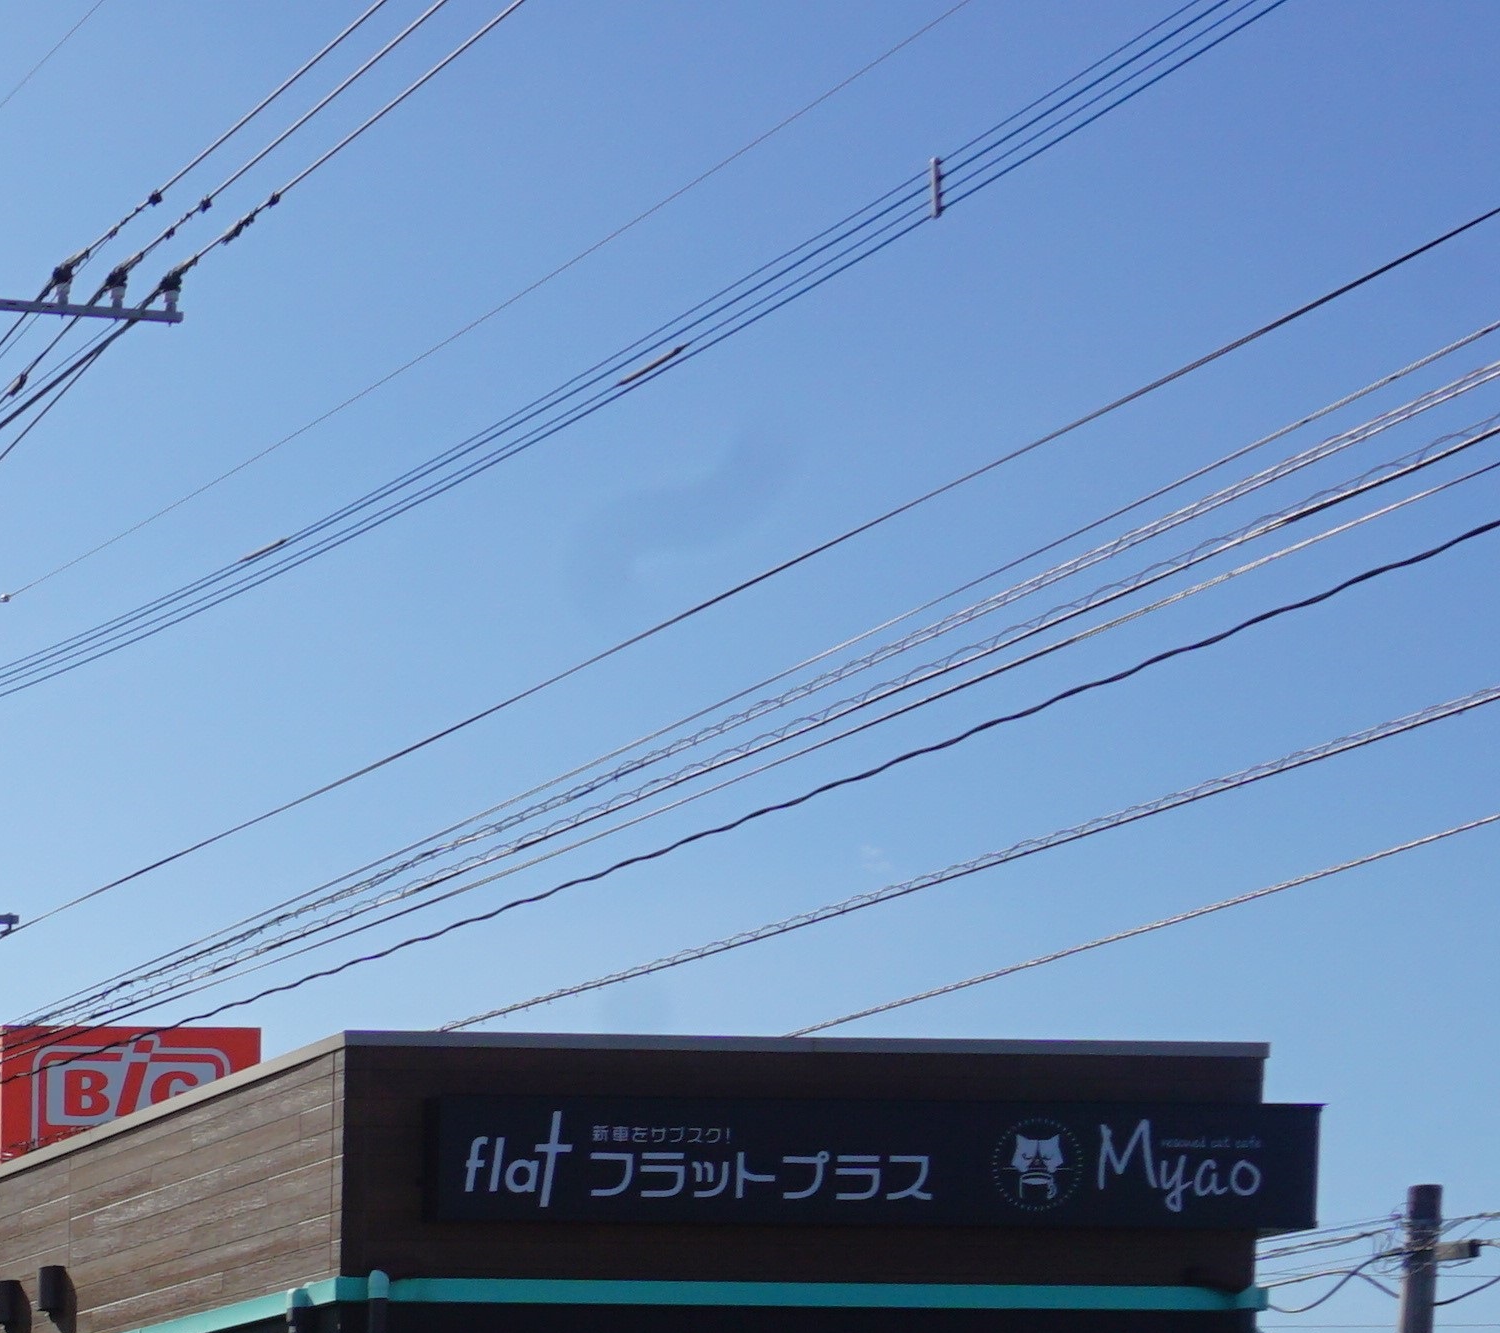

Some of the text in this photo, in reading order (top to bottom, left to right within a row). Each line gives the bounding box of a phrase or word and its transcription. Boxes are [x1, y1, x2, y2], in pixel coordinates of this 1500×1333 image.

[463, 1110, 573, 1208] flat
[589, 1151, 933, 1201] フラットプラス
[1097, 1118, 1262, 1213] Myao
